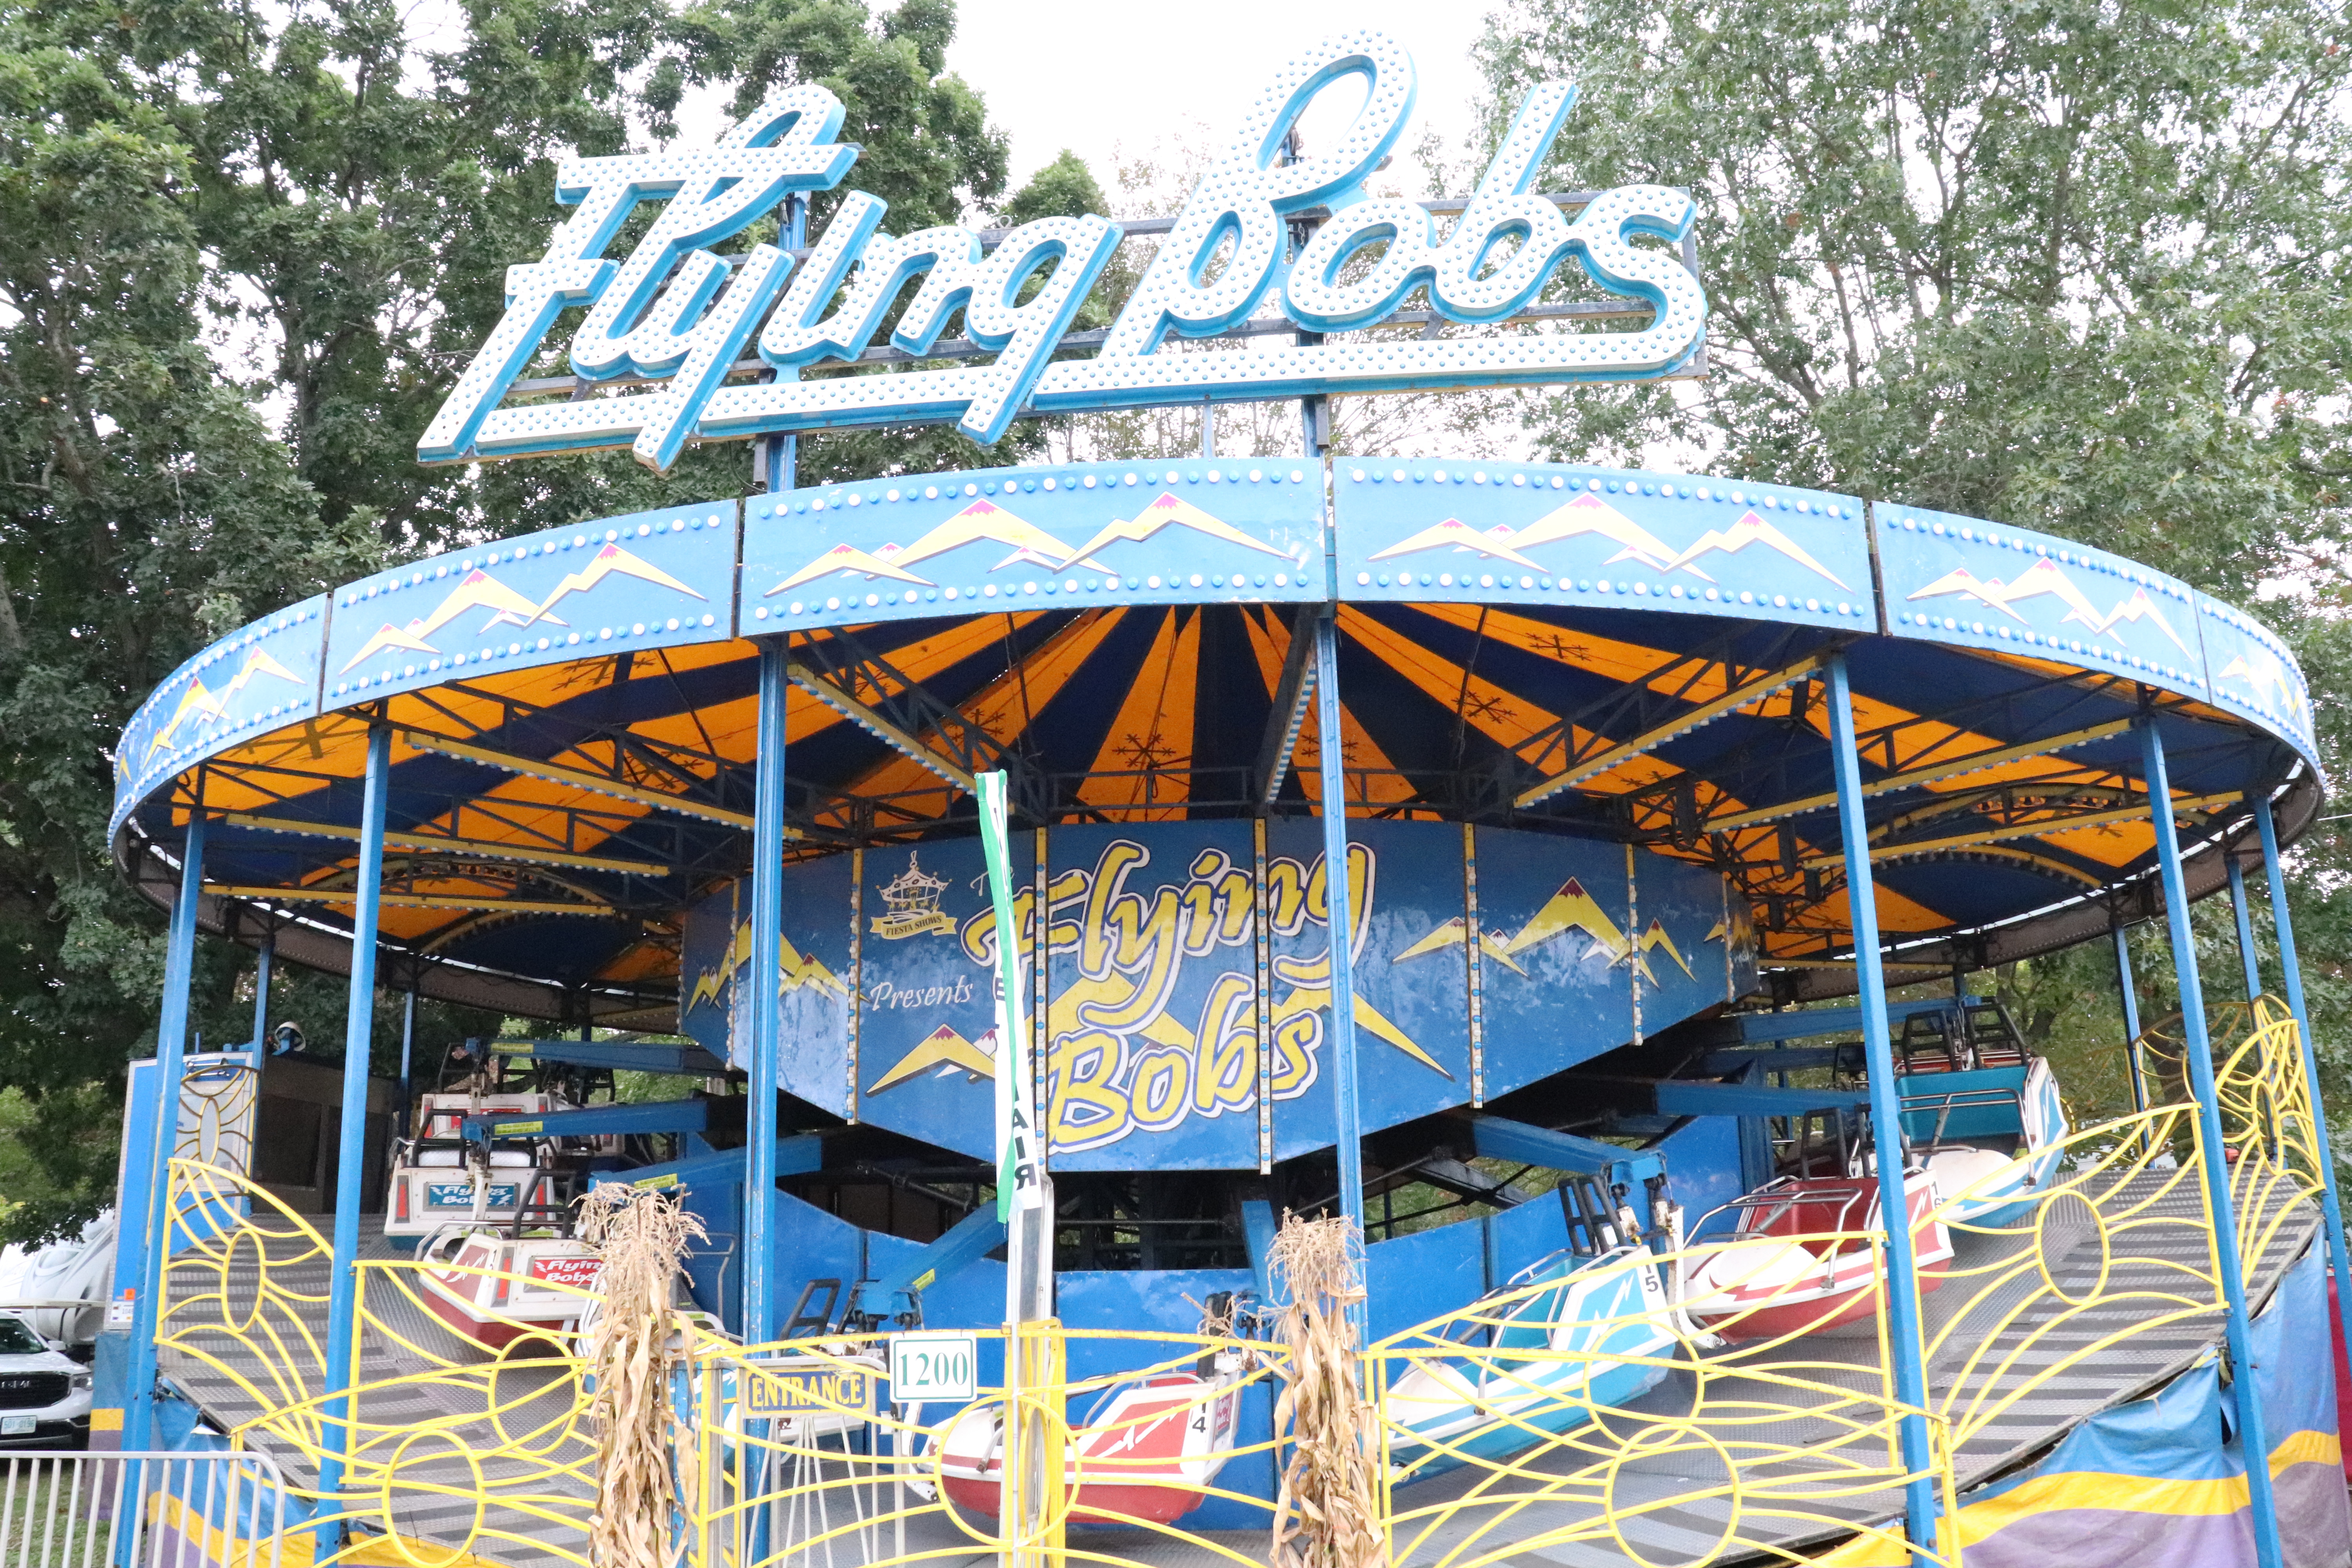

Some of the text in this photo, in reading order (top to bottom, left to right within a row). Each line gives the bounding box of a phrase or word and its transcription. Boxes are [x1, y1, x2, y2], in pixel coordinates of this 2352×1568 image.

[418, 28, 1707, 475] Flying Bobs
[886, 915, 942, 935] FIESTA SHOWS
[961, 839, 1375, 1033] Flying
[870, 975, 973, 1011] Presents
[1029, 972, 1323, 1155] Bobs
[900, 1352, 968, 1386] 1200
[751, 1374, 863, 1407] ENTRANCE
